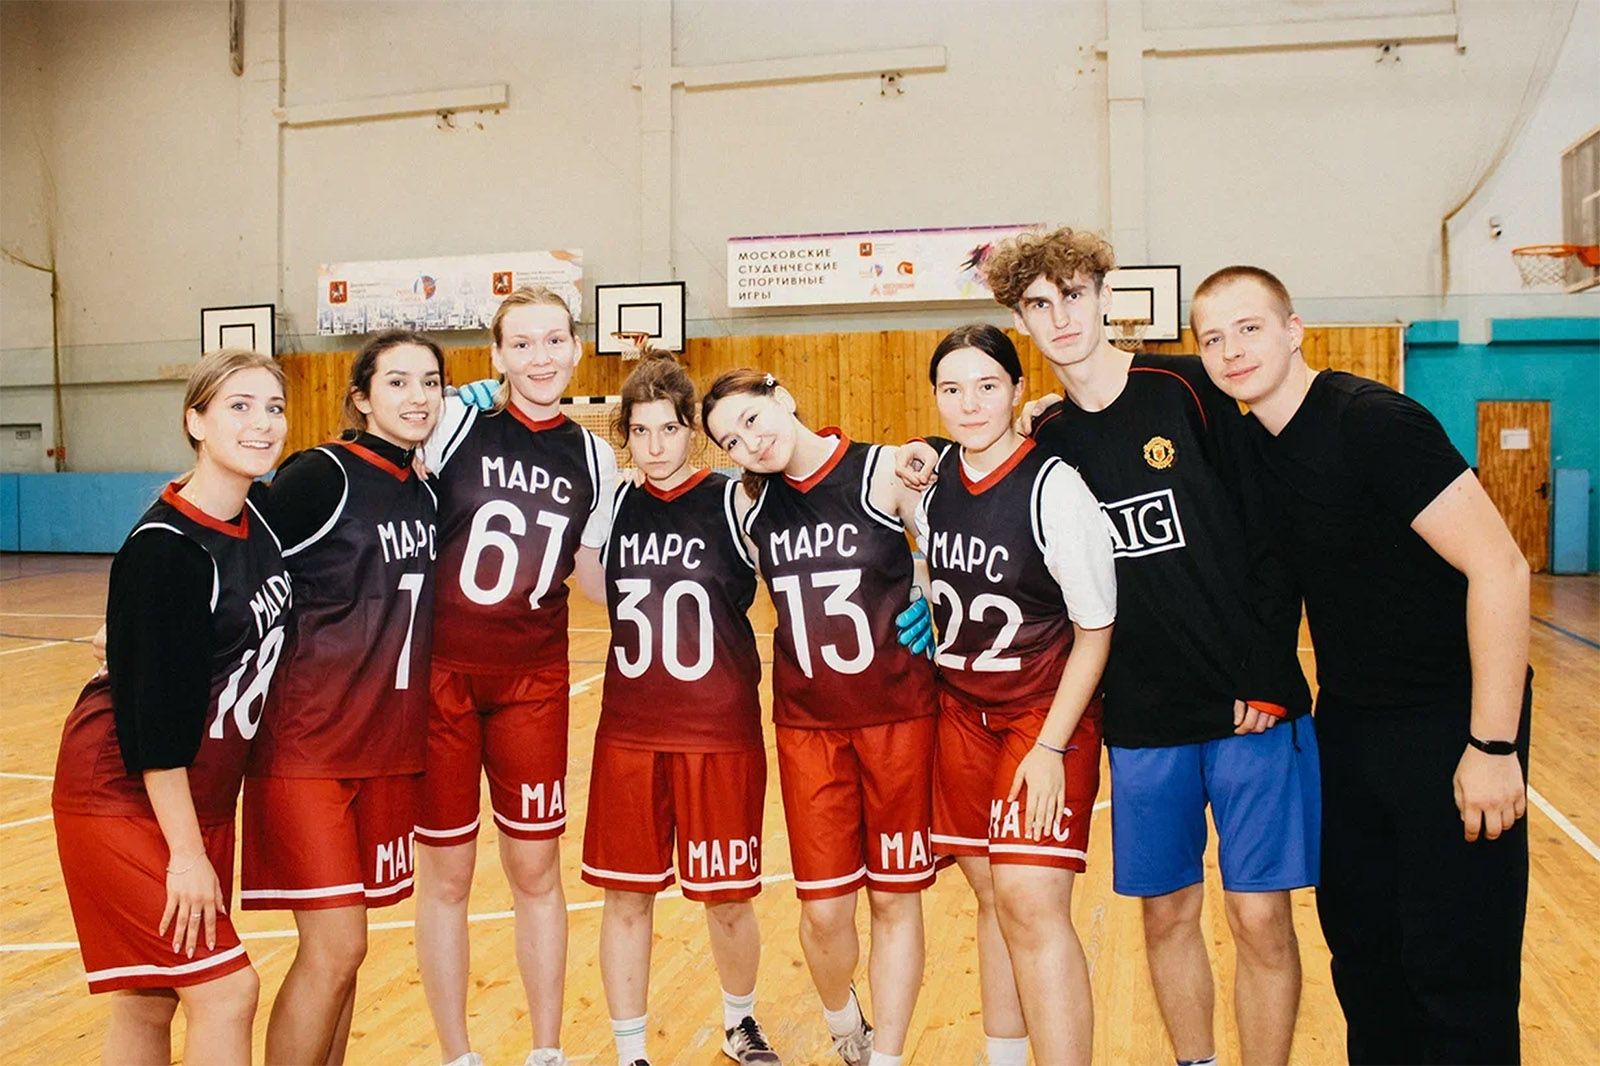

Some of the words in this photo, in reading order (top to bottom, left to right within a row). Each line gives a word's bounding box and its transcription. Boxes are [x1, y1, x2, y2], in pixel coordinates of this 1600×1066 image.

[738, 248, 831, 261] МОСКОВСКИЕ
[738, 262, 838, 274] СТУДЕНЧЕСКИЕ
[738, 276, 825, 288] СПОРТИВНЫЕ
[739, 291, 771, 300] ИГРЫ
[481, 456, 572, 504] МАРС
[377, 519, 437, 563] МАРС
[620, 532, 706, 570] МАРС
[770, 522, 858, 566] МАРС
[932, 531, 1009, 584] МАРС
[614, 578, 715, 681] 30
[772, 568, 874, 679] 13
[931, 579, 1024, 672] 22
[209, 625, 285, 740] 18
[988, 799, 1073, 842] МАС
[688, 835, 758, 879] МАРС
